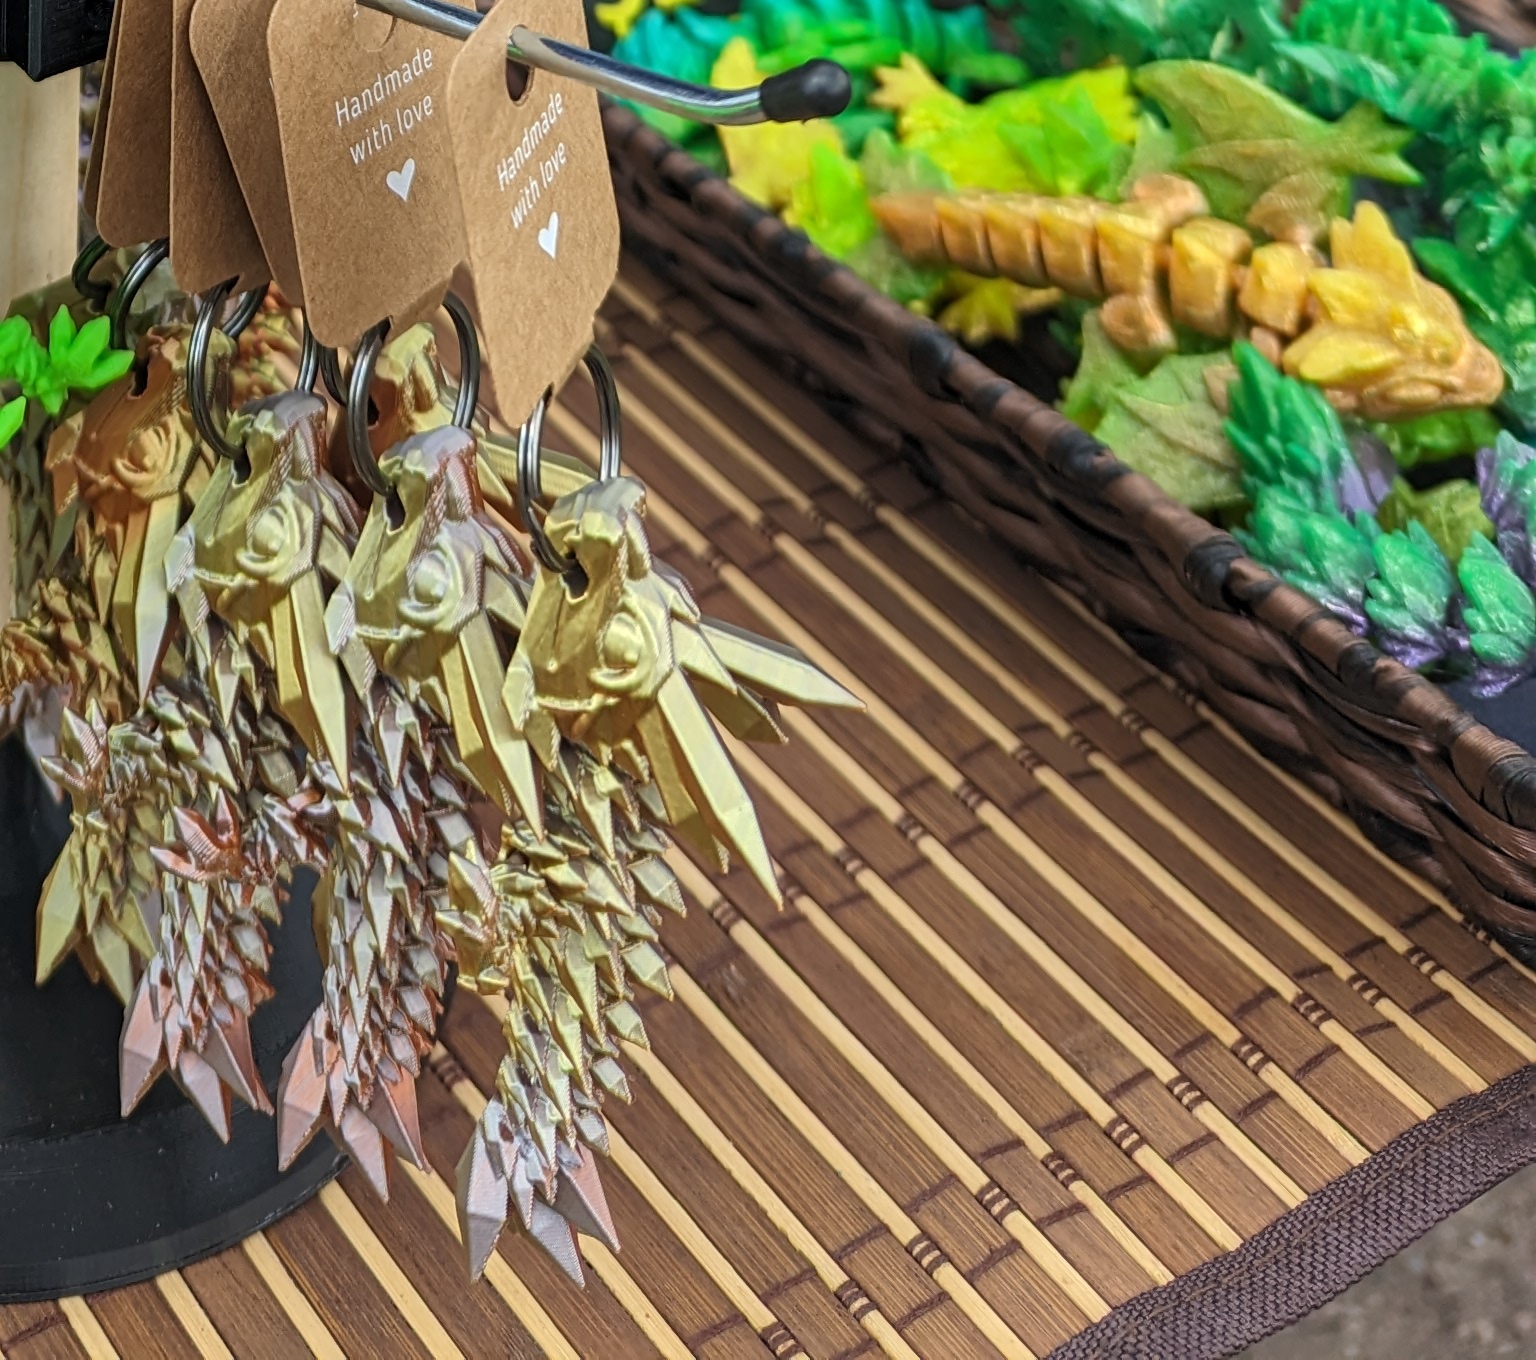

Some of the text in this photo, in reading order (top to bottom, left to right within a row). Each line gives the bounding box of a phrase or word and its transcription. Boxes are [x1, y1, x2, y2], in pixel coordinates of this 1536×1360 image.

[334, 46, 434, 127] Handmade
[349, 94, 434, 165] with love
[495, 91, 564, 192] Handmade
[510, 140, 567, 229] with love
